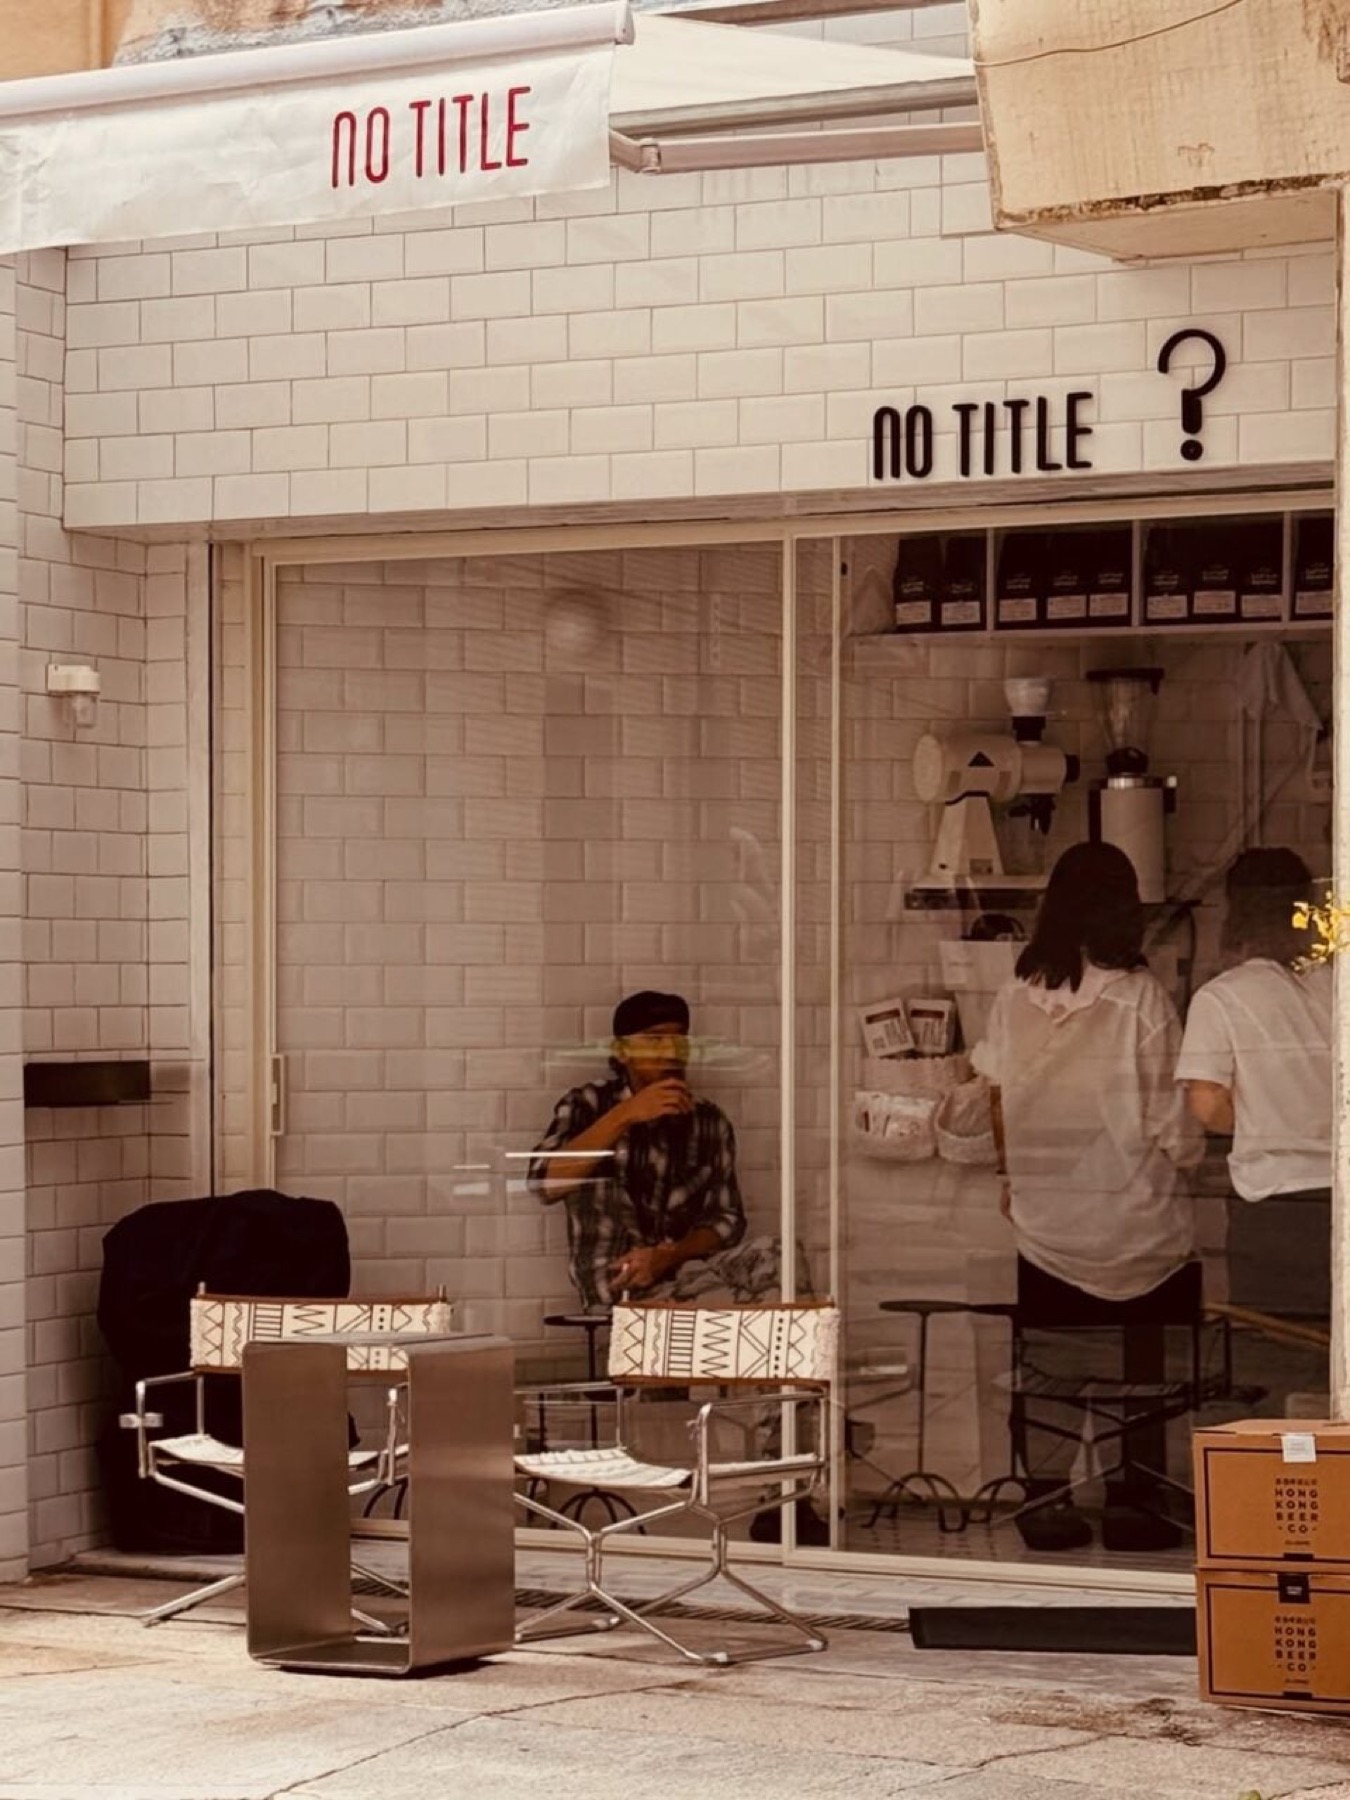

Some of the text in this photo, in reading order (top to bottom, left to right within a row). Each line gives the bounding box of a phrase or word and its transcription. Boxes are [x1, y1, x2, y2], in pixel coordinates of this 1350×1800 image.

[332, 86, 531, 188] NO TITLE
[872, 404, 934, 480] NO
[951, 391, 1094, 478] TITLE
[1274, 1487, 1320, 1499] HONG
[1275, 1499, 1320, 1511] KONG
[1275, 1511, 1320, 1523] BEER
[1273, 1625, 1318, 1638] HONG
[1274, 1637, 1318, 1649] KONG
